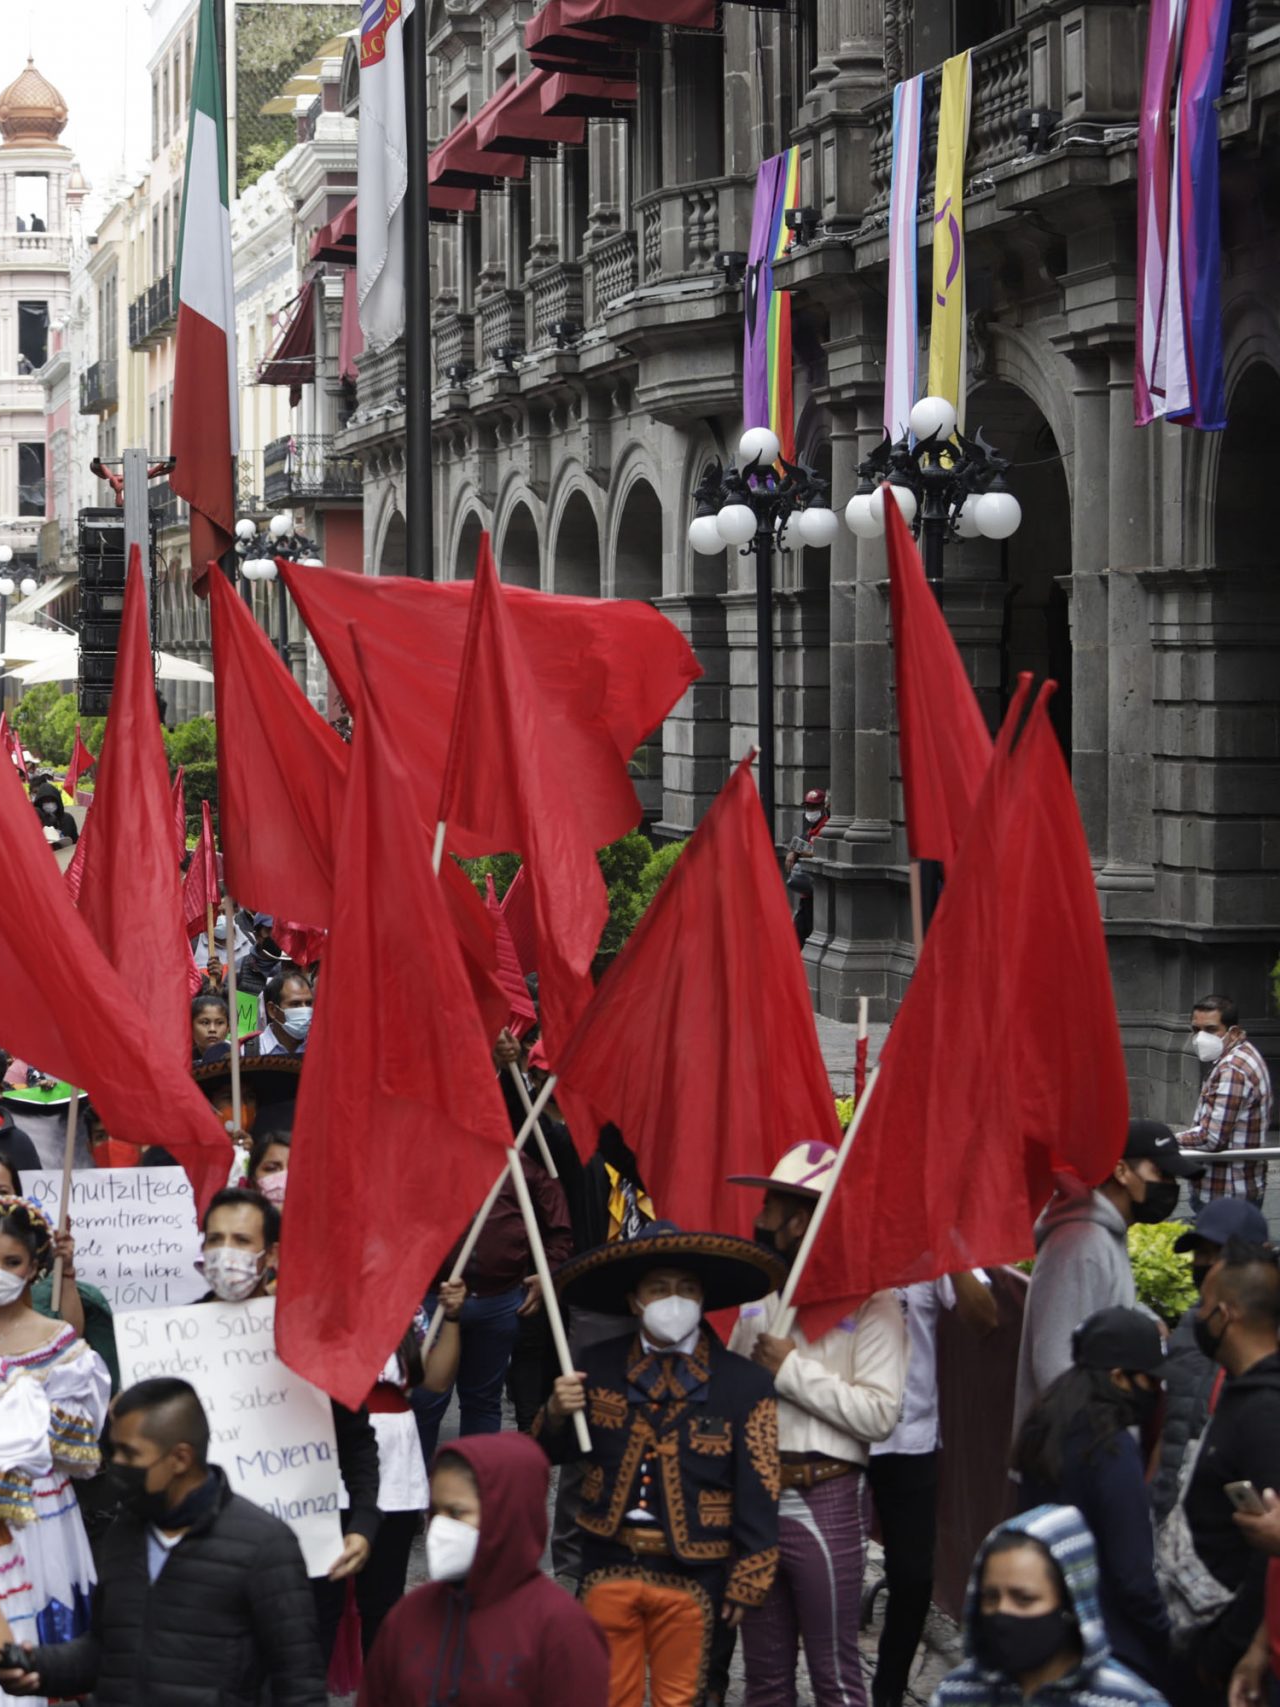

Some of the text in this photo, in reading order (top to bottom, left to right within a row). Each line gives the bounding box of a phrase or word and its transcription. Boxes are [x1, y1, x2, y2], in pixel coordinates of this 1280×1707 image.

[70, 1174, 193, 1204] huitzilteco
[117, 1237, 183, 1256] nuestro
[117, 1262, 133, 1279] la
[144, 1262, 184, 1279] libre
[125, 1306, 276, 1349] Si no sabe
[231, 1386, 289, 1412] saber
